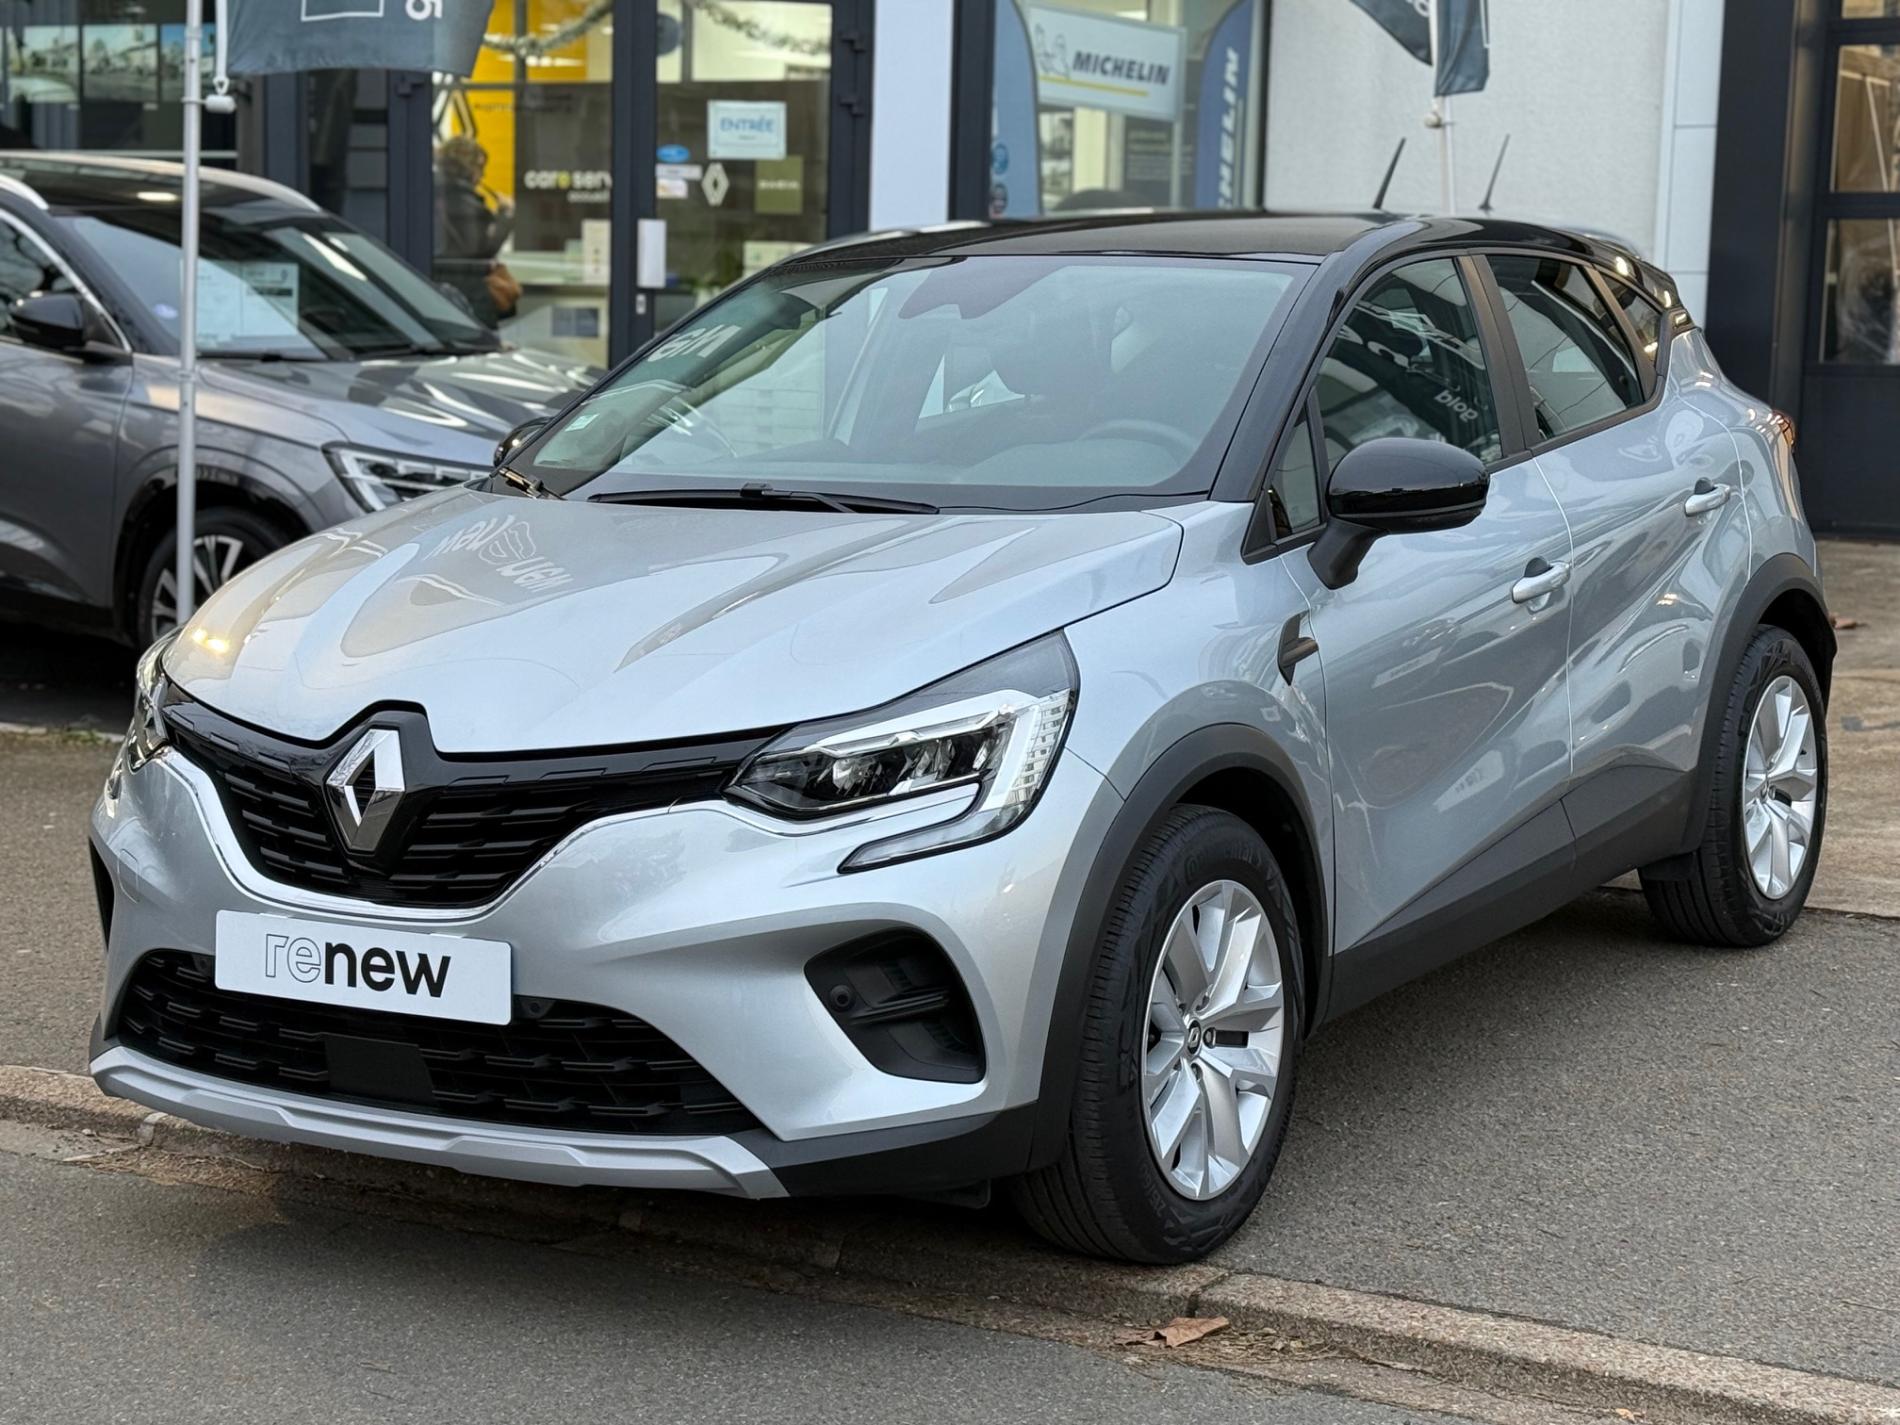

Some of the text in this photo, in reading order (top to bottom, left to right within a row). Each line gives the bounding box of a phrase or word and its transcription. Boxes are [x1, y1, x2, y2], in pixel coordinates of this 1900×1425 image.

[1072, 50, 1171, 86] MICHELIN
[719, 115, 774, 133] ENTRÉE
[264, 933, 452, 998] renew
